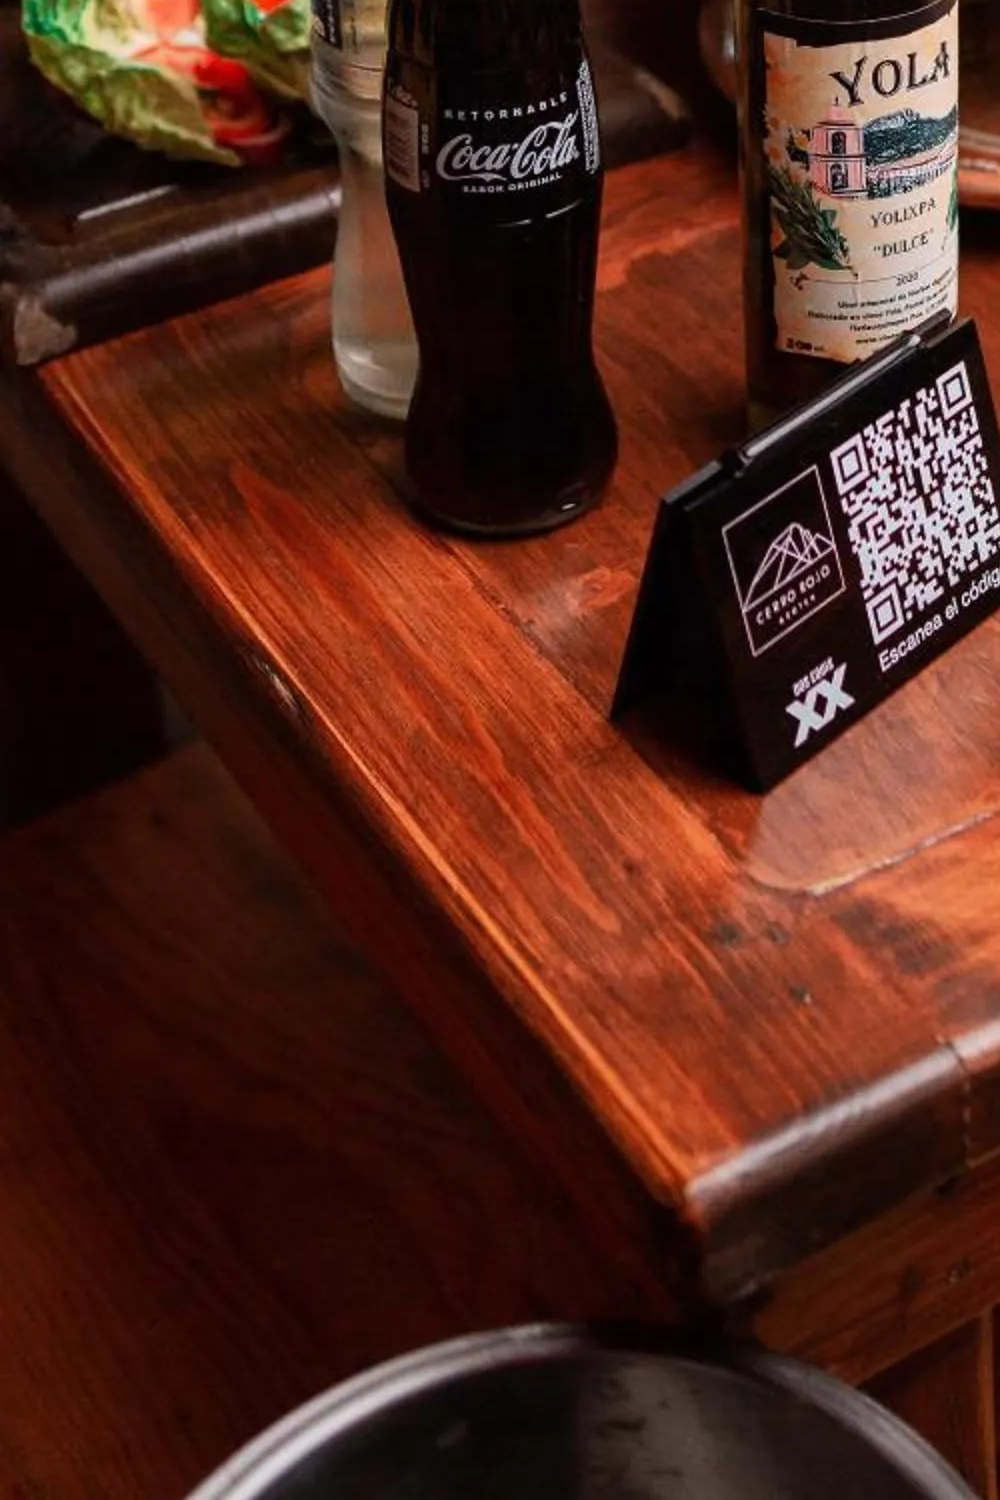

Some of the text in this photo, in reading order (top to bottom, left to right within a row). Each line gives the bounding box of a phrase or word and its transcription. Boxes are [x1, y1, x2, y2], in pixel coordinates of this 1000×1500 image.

[443, 91, 569, 122] RETORNABLE
[828, 41, 950, 108] YOLA
[436, 108, 580, 182] Coca-Cola
[462, 171, 562, 194] SABOR ORIGINAL
[870, 196, 936, 228] YOLIXPA
[878, 613, 944, 673] Escanea
[945, 596, 959, 620] el
[785, 661, 856, 749] XX
